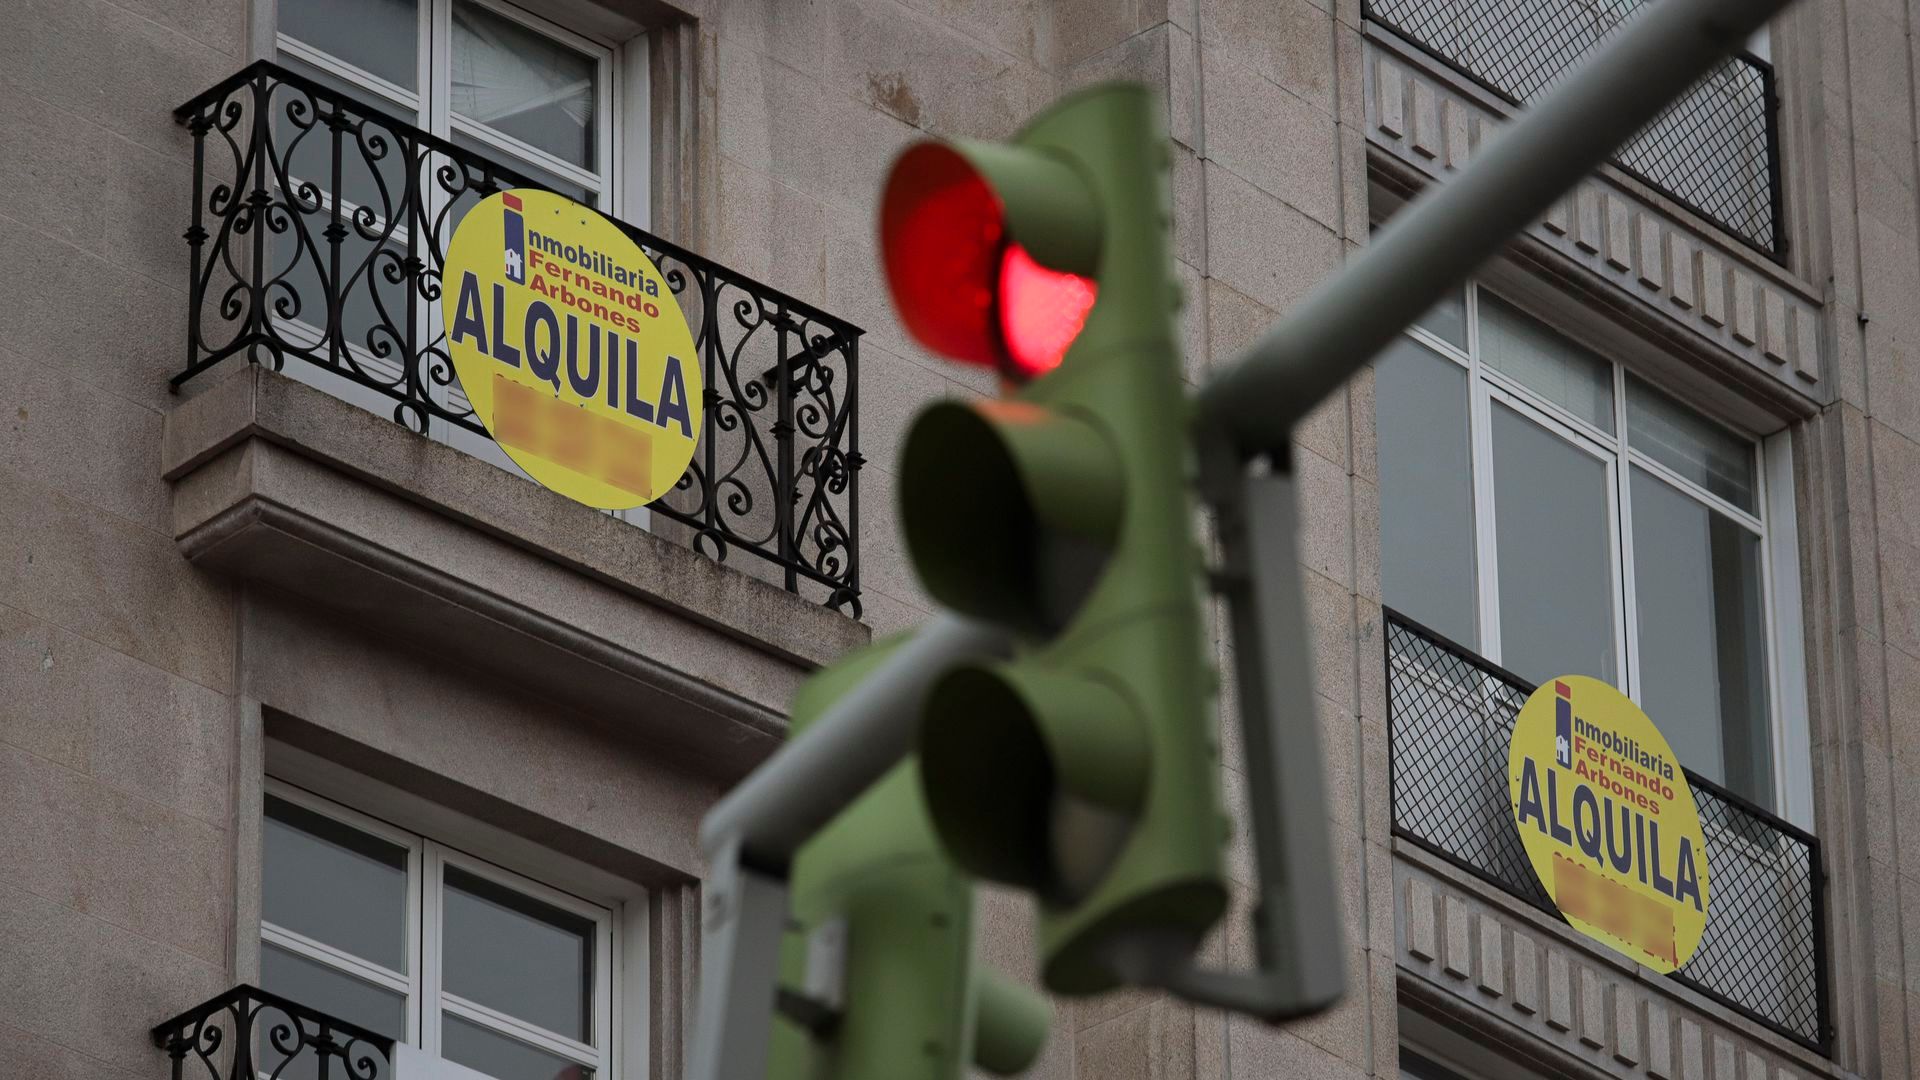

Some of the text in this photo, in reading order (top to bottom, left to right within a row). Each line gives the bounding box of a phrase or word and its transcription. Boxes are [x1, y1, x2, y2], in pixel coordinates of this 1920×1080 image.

[529, 250, 660, 318] Fernando
[529, 274, 641, 333] Arbones
[451, 270, 693, 439] ALQUILA
[1575, 736, 1674, 801] Fernando
[1575, 759, 1660, 815] Arbones
[1518, 756, 1704, 912] ALQUILA
